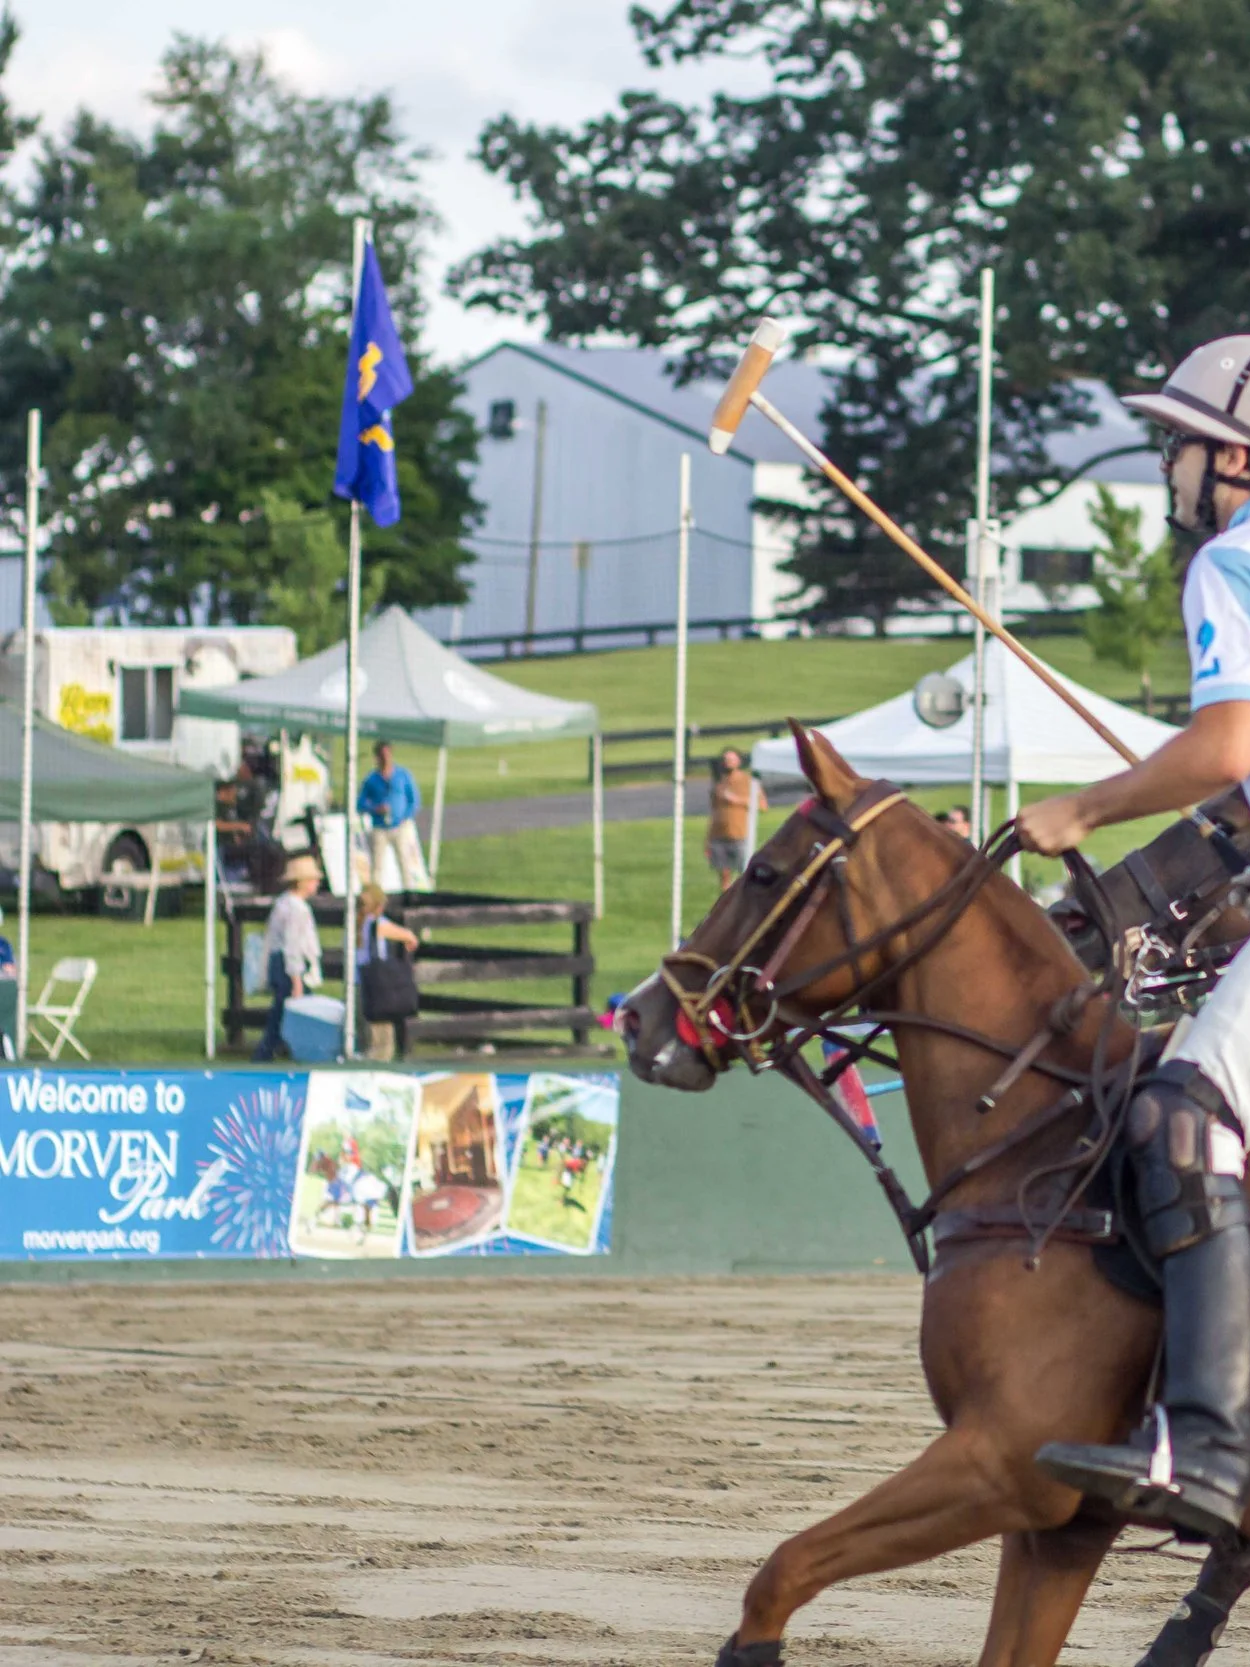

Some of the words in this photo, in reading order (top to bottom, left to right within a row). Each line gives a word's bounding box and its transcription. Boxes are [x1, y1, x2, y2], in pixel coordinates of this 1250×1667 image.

[1196, 617, 1220, 681] 2
[7, 1074, 148, 1114] Welcome
[154, 1079, 185, 1114] to
[0, 1129, 179, 1179] MORVEN
[98, 1156, 230, 1225] Park
[23, 1227, 160, 1254] morvenpark.org
